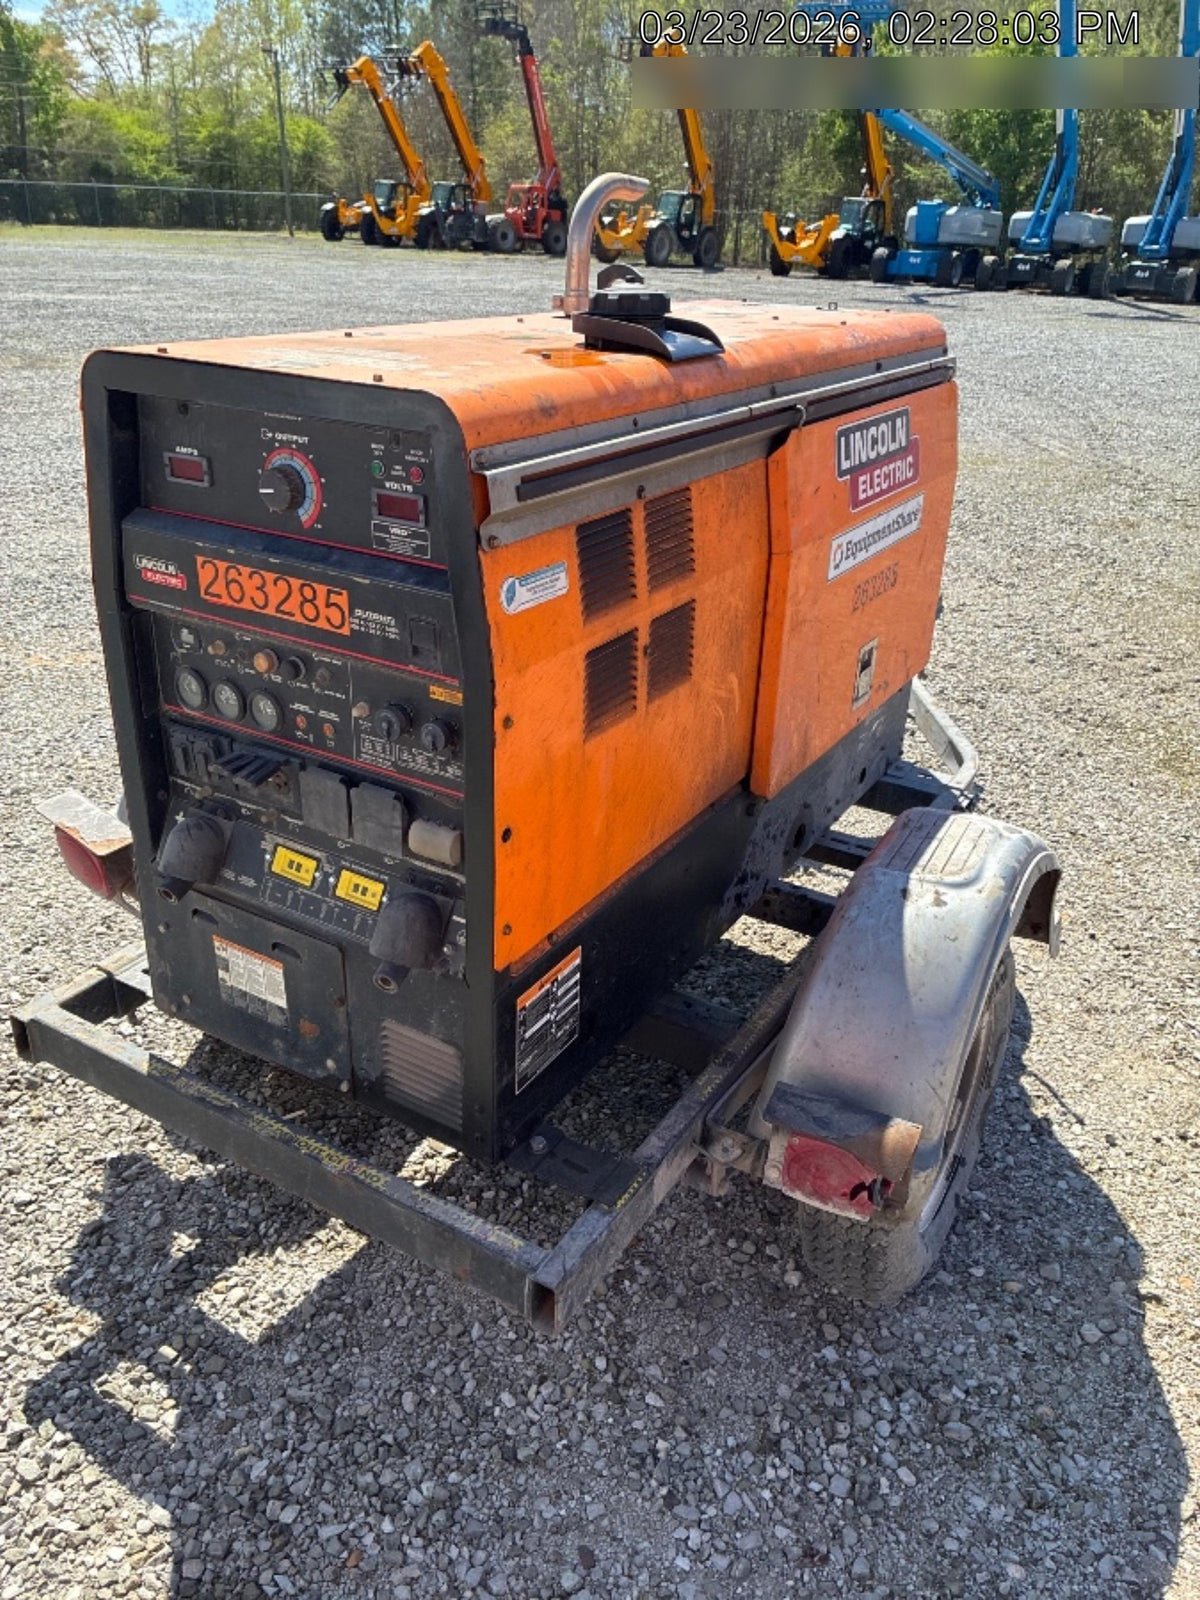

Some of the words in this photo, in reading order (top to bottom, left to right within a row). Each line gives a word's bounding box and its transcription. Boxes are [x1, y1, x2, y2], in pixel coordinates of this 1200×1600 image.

[275, 431, 309, 444] OUTPUT
[840, 415, 908, 472] LINCOLN
[858, 454, 915, 501] ELECTRIC
[135, 555, 178, 575] LINCOLN
[199, 559, 347, 631] 263285
